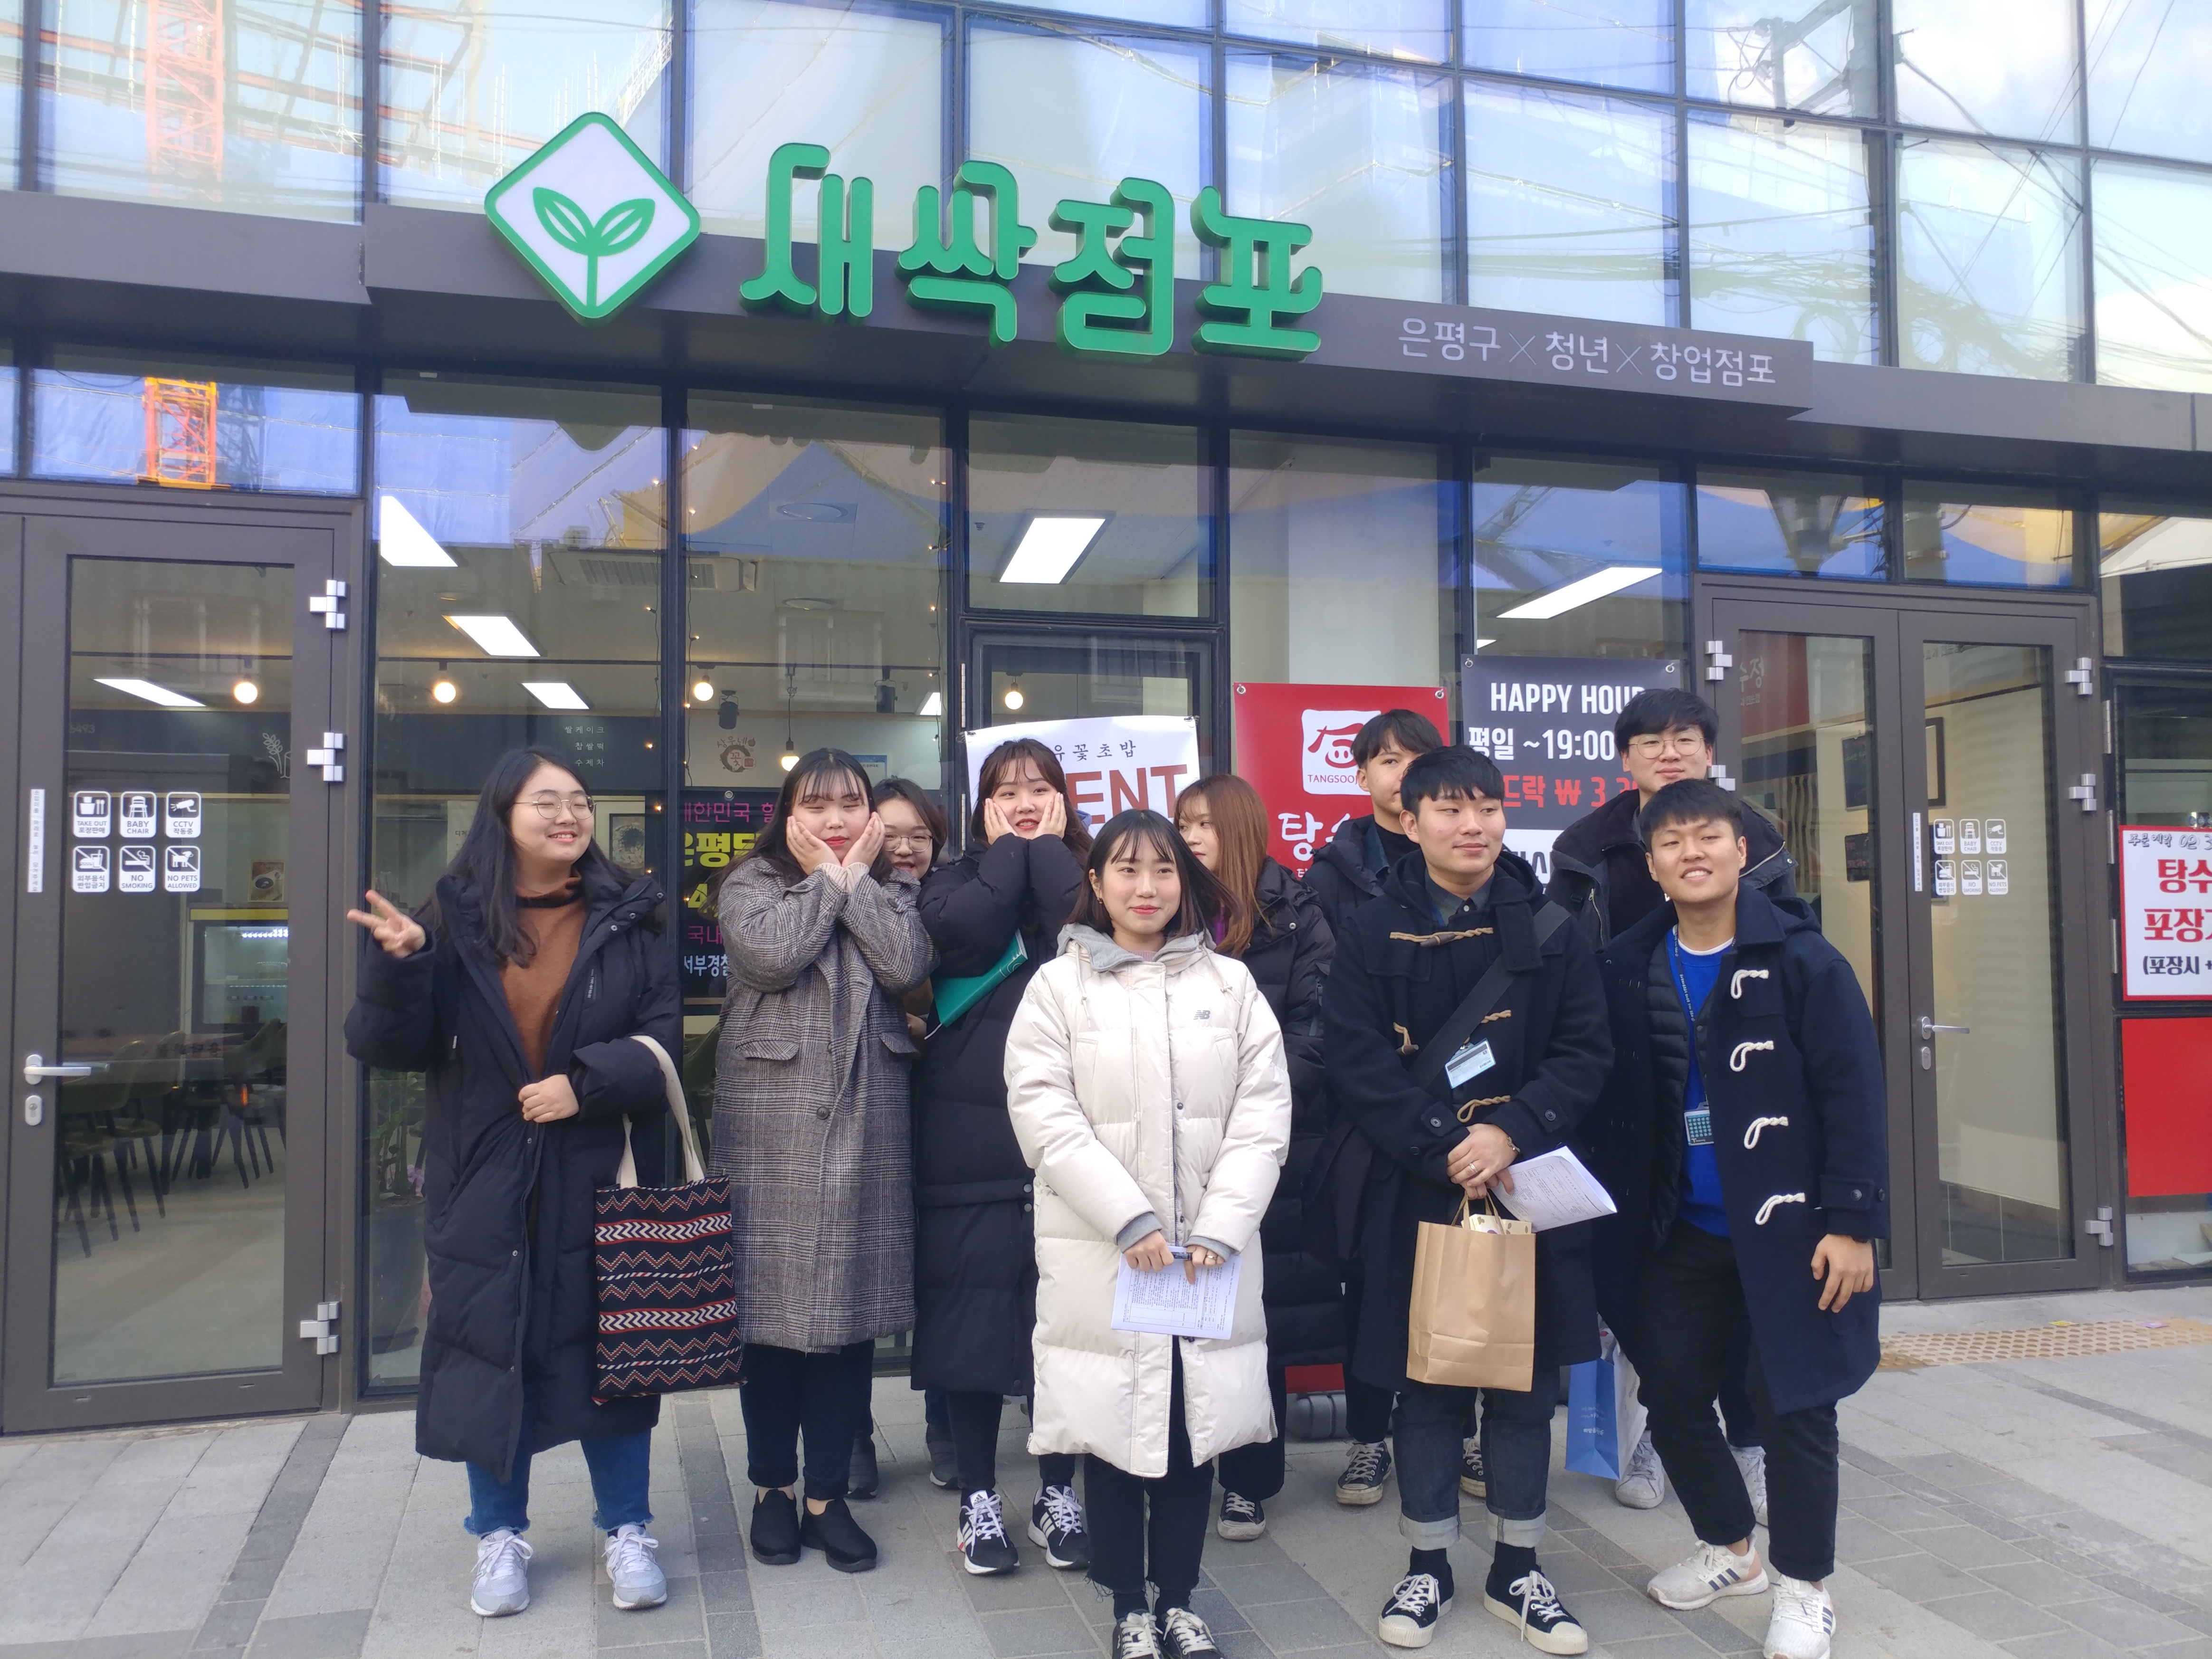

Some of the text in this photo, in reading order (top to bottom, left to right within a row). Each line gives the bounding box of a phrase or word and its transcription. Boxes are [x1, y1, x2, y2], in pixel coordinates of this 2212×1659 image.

[739, 142, 1322, 362] 새싹점포
[1398, 317, 1501, 362] 은평구
[1545, 330, 1608, 375] 청년
[1649, 342, 1776, 388] 창업점포
[1491, 682, 1646, 715] HAPPY HOU
[1468, 727, 1514, 761] 평일
[575, 758, 605, 767] 수제차
[2128, 833, 2173, 848] 주문예약
